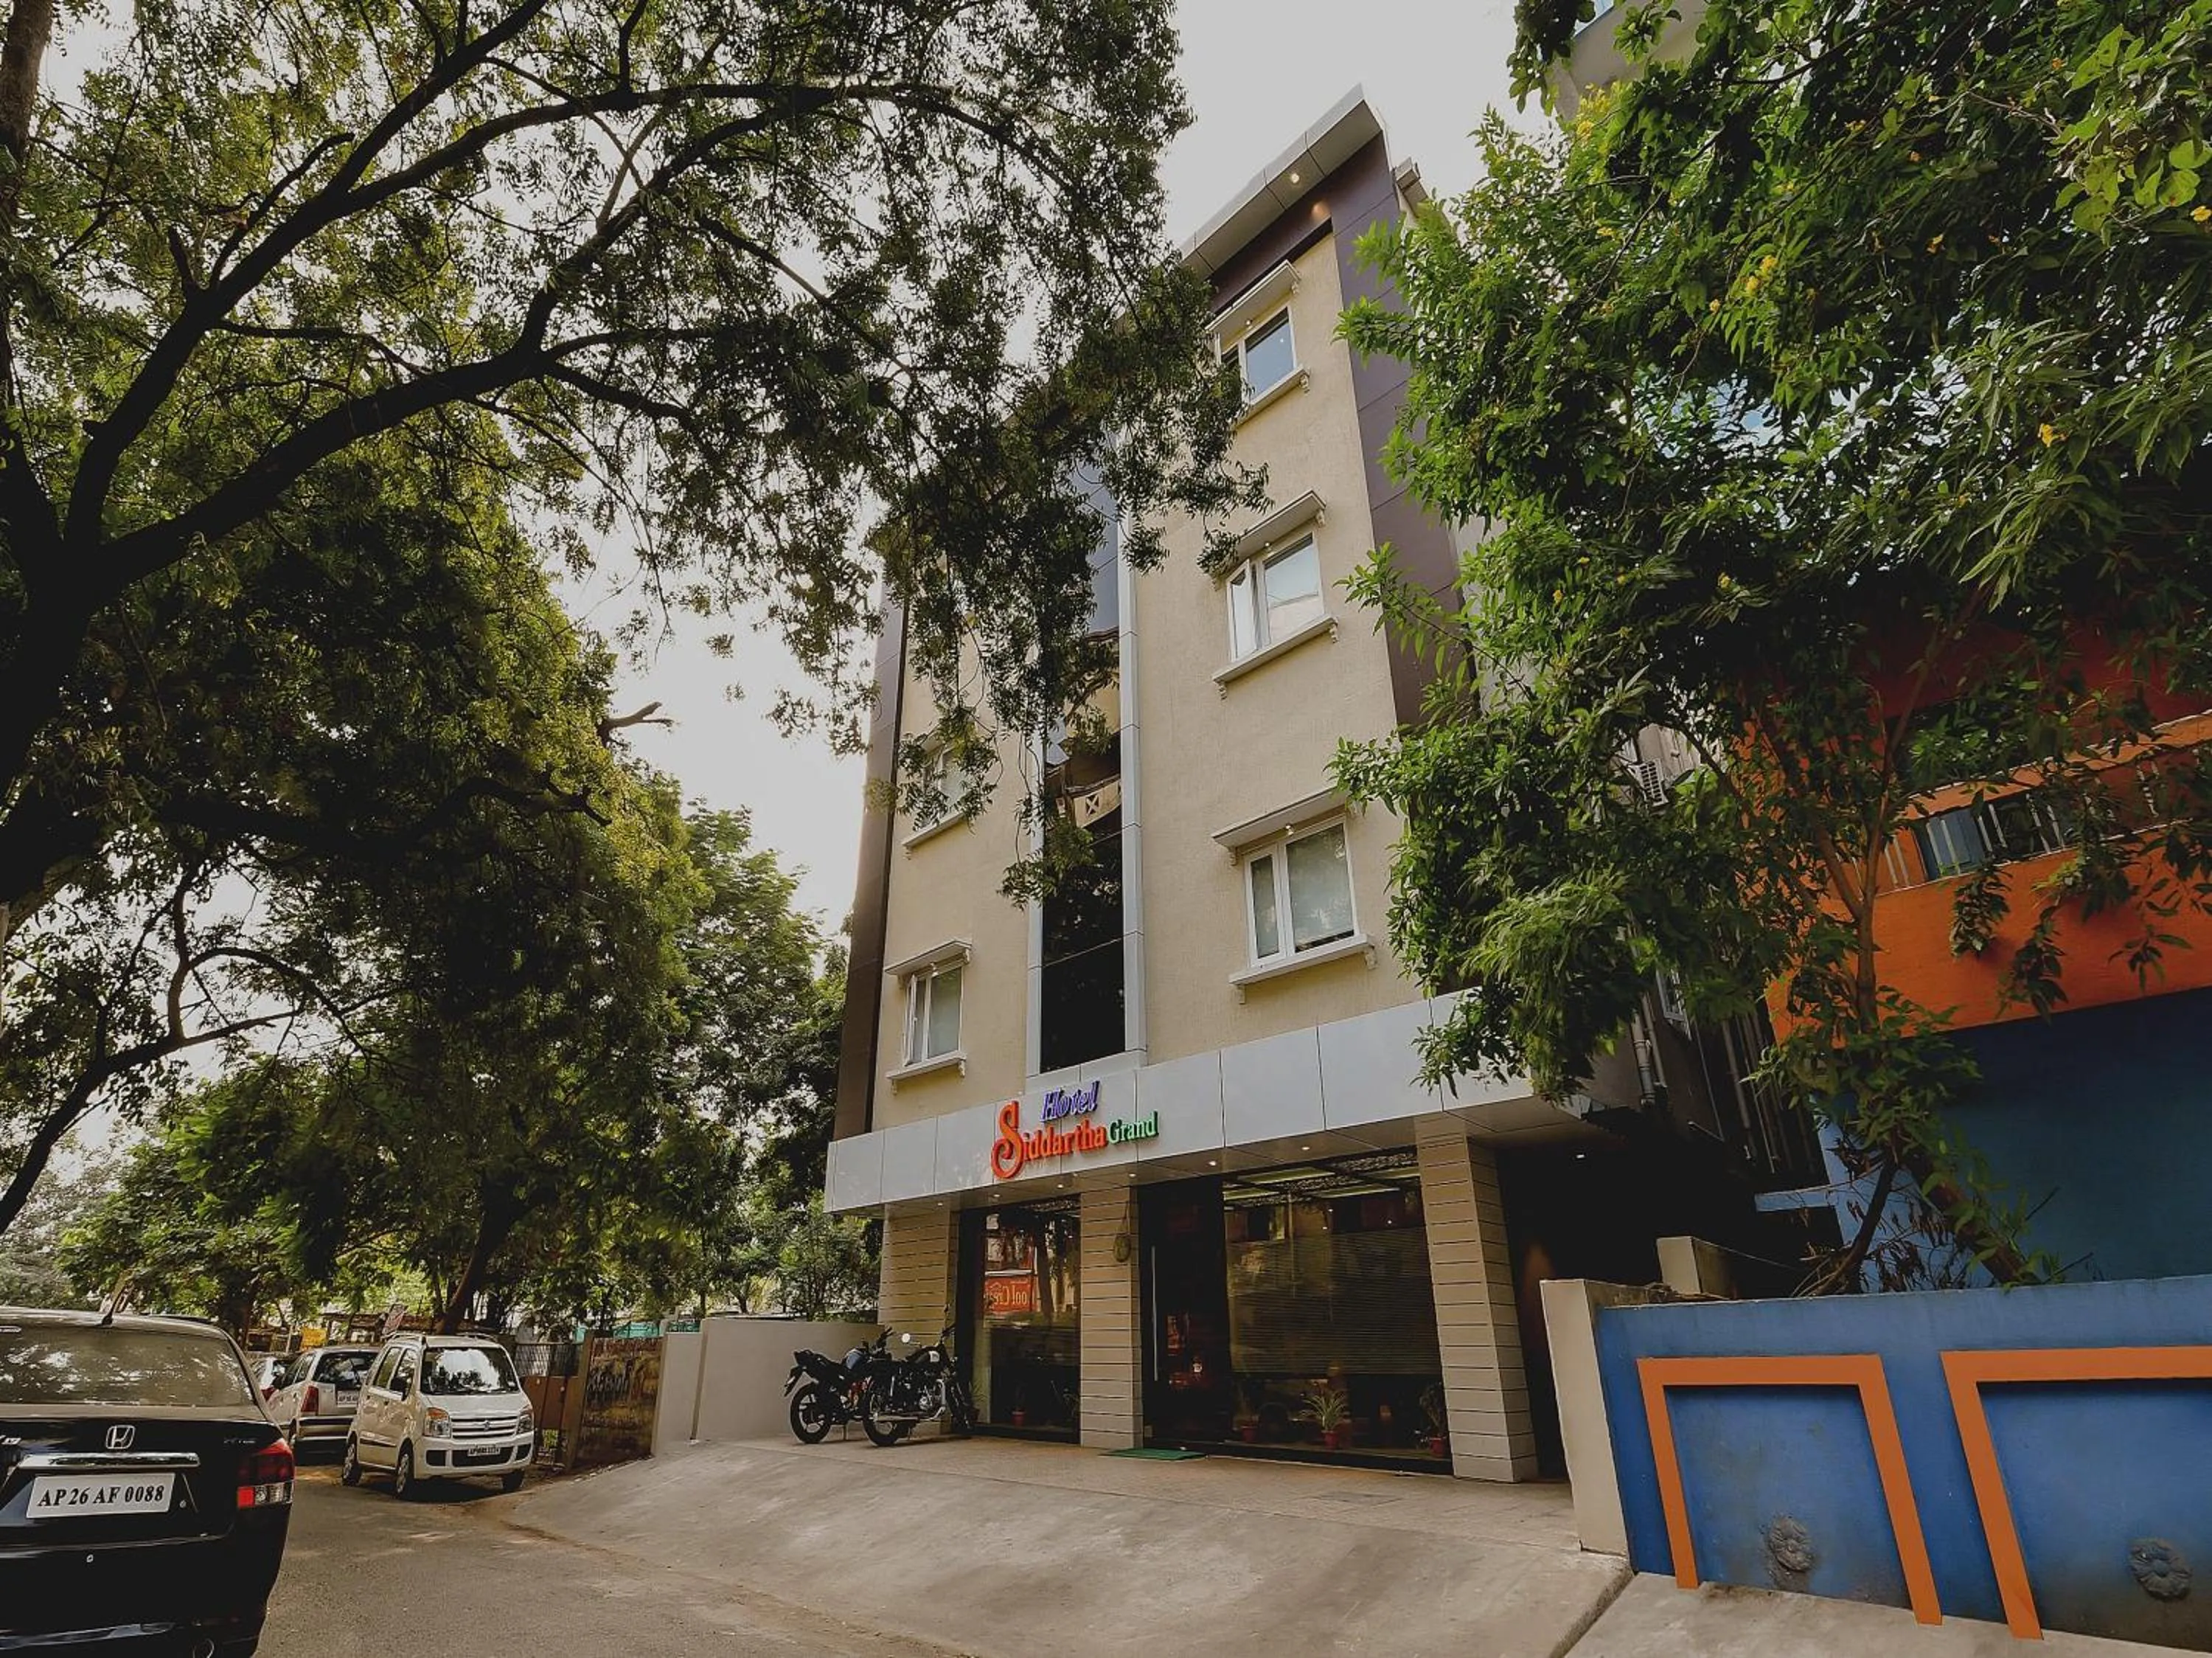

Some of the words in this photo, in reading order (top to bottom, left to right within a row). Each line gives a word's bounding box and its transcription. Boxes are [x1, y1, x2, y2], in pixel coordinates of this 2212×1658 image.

[1040, 1081, 1100, 1123] Hotel
[991, 1100, 1108, 1179] Siddartha
[1107, 1110, 1158, 1145] Grand
[37, 1488, 67, 1507] AP
[67, 1487, 90, 1505] 26
[92, 1486, 121, 1504] AF
[125, 1485, 164, 1503] 0088
